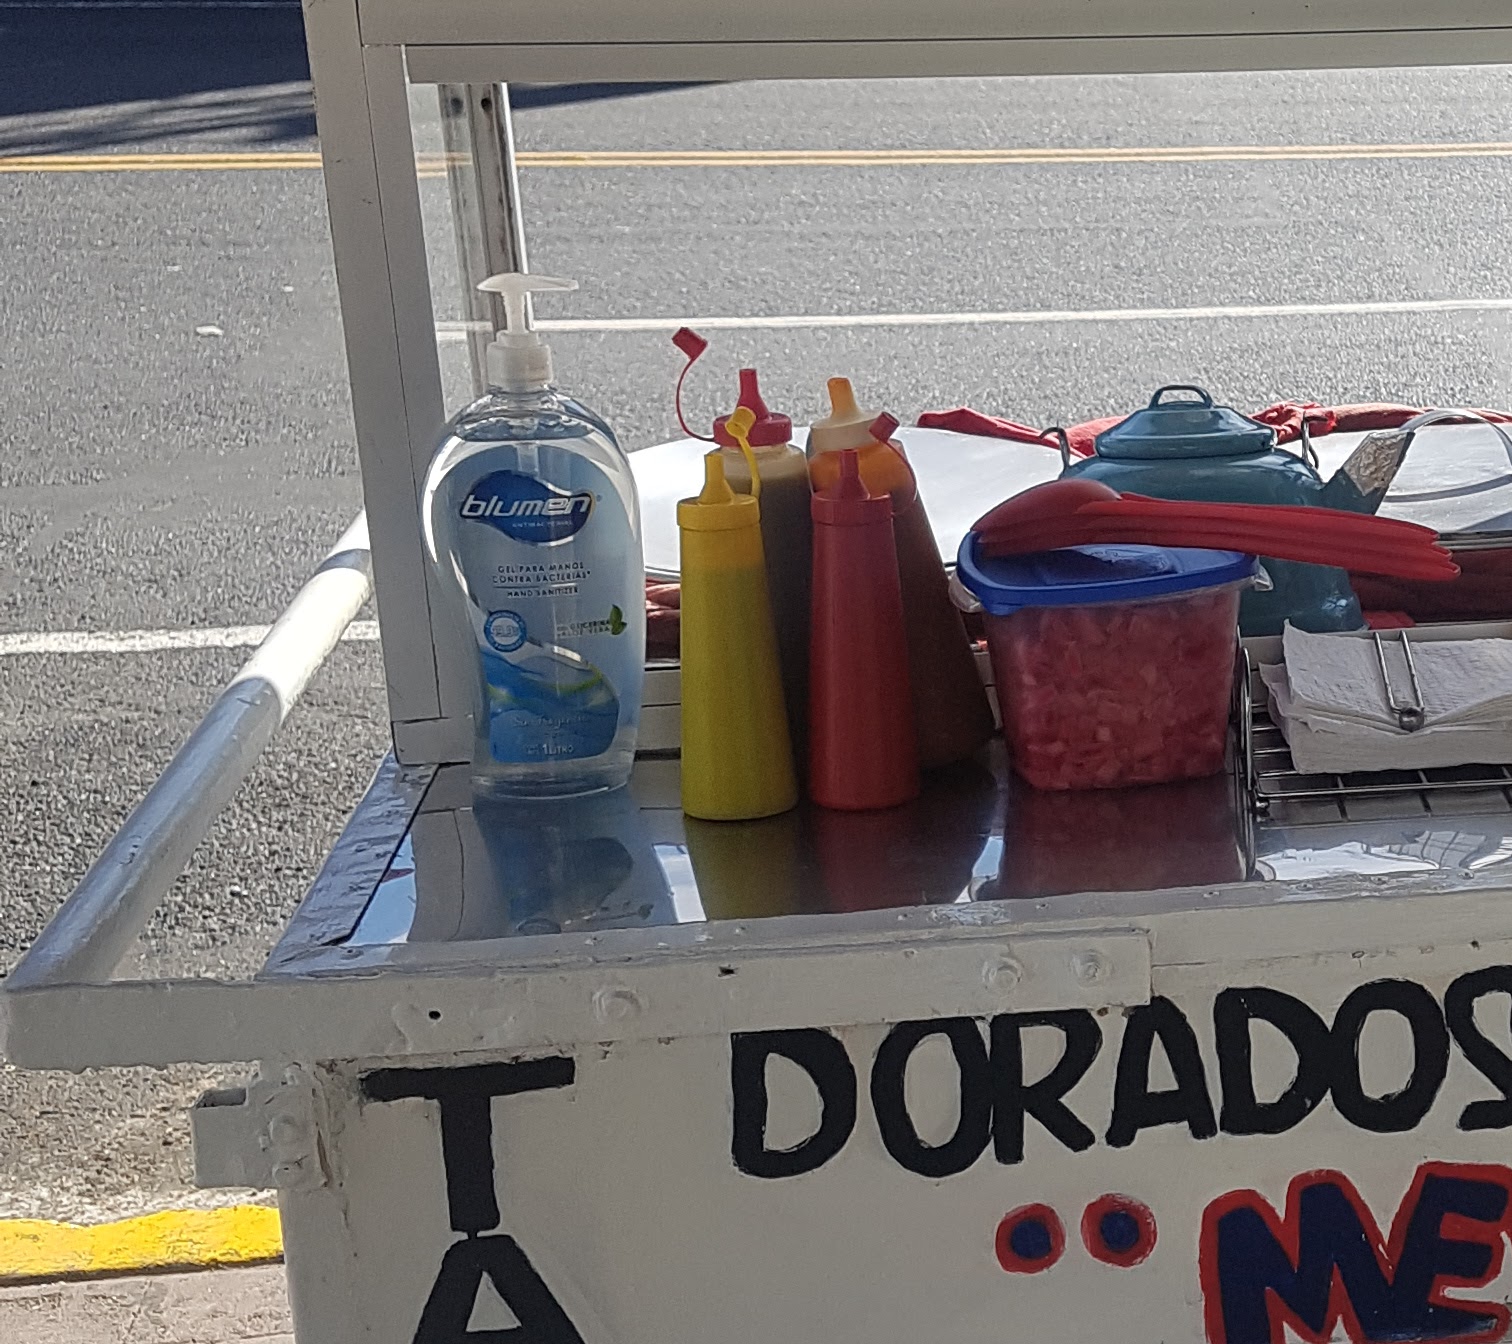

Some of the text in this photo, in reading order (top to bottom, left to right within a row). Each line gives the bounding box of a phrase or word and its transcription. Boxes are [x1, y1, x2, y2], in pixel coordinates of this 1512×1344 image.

[461, 494, 591, 517] blumen
[497, 561, 584, 574] GEL PARA MANOS
[492, 575, 532, 584] CONTRA
